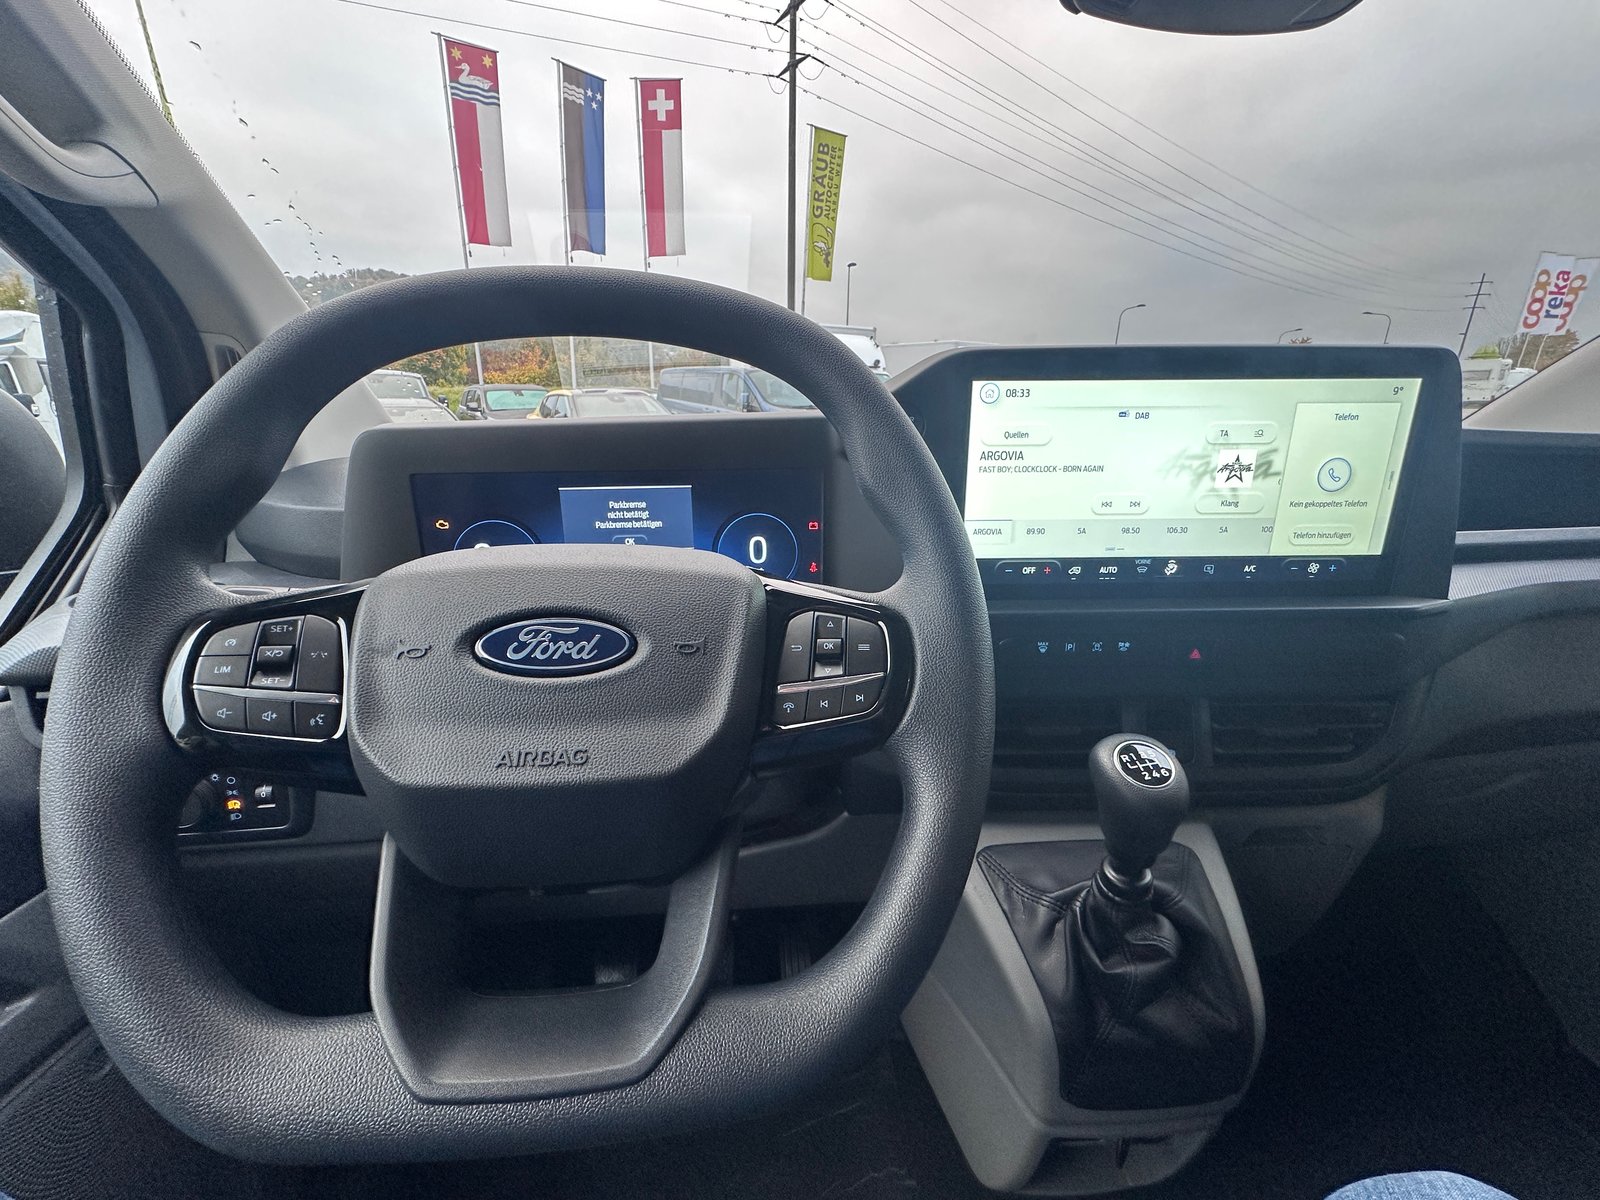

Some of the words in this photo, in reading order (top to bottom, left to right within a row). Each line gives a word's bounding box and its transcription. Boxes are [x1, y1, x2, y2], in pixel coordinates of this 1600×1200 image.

[812, 143, 830, 218] GRÄUB
[824, 145, 837, 219] AUTOCENTER
[1544, 270, 1571, 319] reka
[1522, 269, 1551, 330] coop
[1005, 388, 1031, 398] 08:33
[1135, 412, 1150, 420] DAB
[1334, 412, 1359, 421] Telefon
[1003, 431, 1029, 440] Quellen
[1219, 429, 1229, 438] TA
[979, 451, 1024, 461] ARGOVIA
[978, 465, 995, 474] FAST
[1014, 465, 1057, 473] CLOCKCLOCK
[1063, 465, 1082, 473] BORN
[1083, 465, 1104, 473] AGAIN
[608, 501, 647, 509] Parkbremse
[1220, 499, 1240, 509] Klang
[1289, 500, 1303, 508] Kein
[1304, 500, 1342, 510] gekoppeltes
[1344, 500, 1368, 508] Telefon
[607, 511, 624, 519] nicht
[624, 511, 649, 519] betätigt
[595, 521, 632, 529] Parkbremse
[633, 521, 663, 529] betätigen
[973, 528, 1002, 536] ARGOVIA
[1026, 528, 1046, 536] 89.90
[1077, 528, 1087, 536] 5A
[1121, 527, 1141, 535] 98.50
[1166, 526, 1188, 535] 106.30
[1219, 526, 1228, 534] 5A
[1293, 530, 1316, 540] Telefon
[1317, 530, 1352, 540] hinzufügen
[749, 536, 767, 564] 0
[1022, 566, 1036, 575] OFF
[1099, 566, 1117, 574] AUTO
[1244, 565, 1256, 573] A/C
[506, 625, 601, 661] Ford
[214, 666, 231, 674] LIM
[498, 749, 589, 768] AIRBAG
